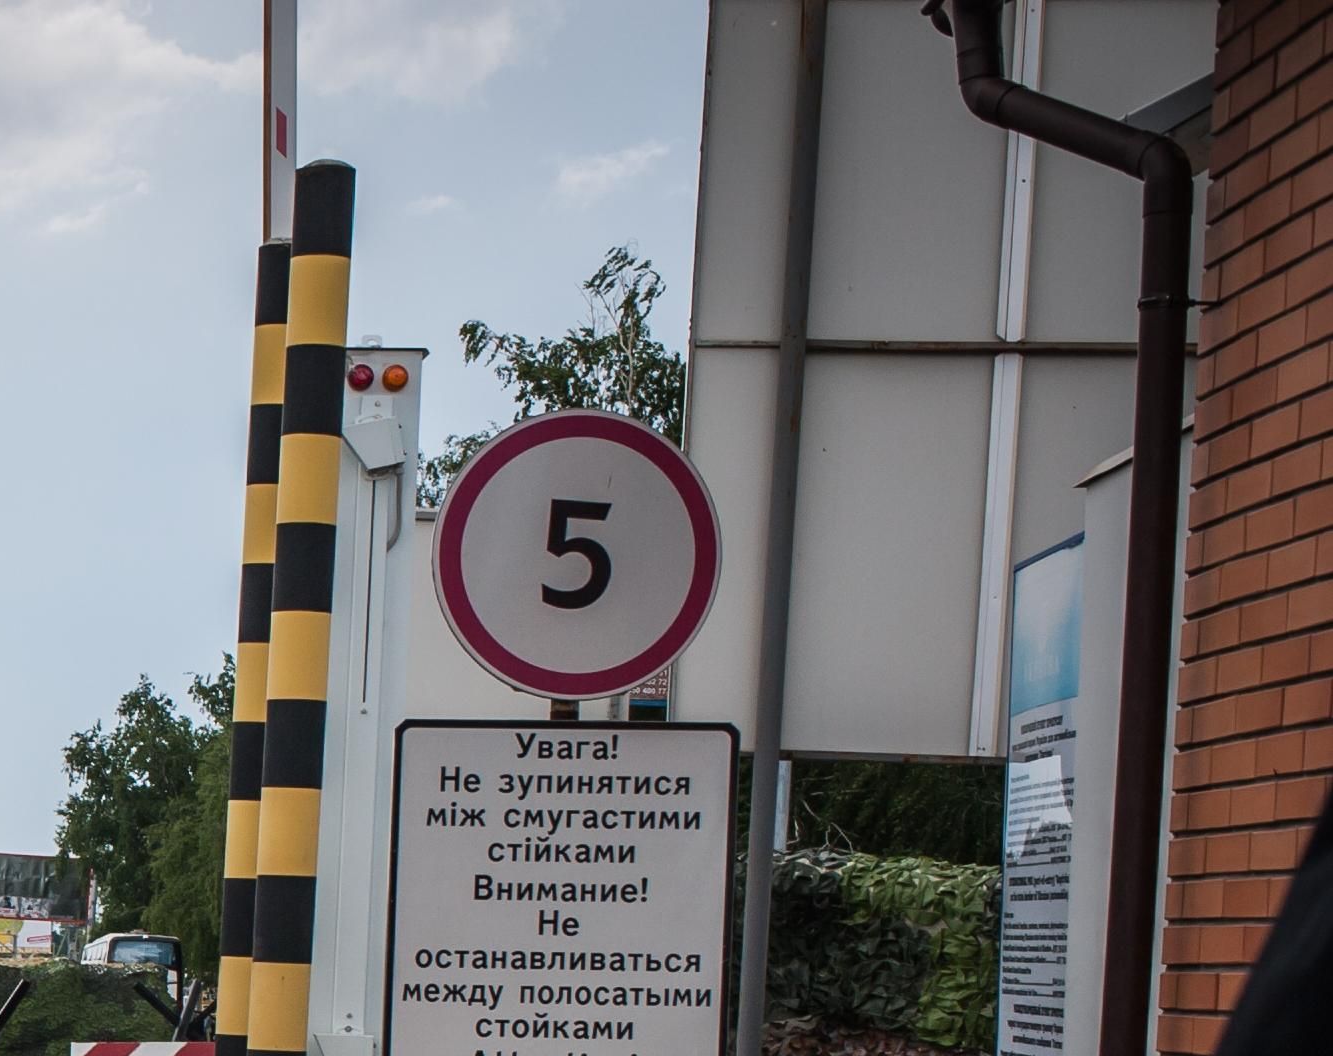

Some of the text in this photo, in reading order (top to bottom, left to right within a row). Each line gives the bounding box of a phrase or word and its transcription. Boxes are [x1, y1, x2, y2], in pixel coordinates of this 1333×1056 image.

[542, 499, 612, 609] 5
[516, 733, 618, 760] Увага!
[441, 766, 690, 800] Не зупинятися
[427, 802, 700, 835] між смугастими
[488, 834, 635, 863] стійками
[475, 875, 647, 902] Внимание!
[539, 910, 579, 936] Не
[416, 949, 700, 972] останавливаться
[403, 984, 711, 1010] между полосатыми
[476, 1010, 633, 1040] стойками
